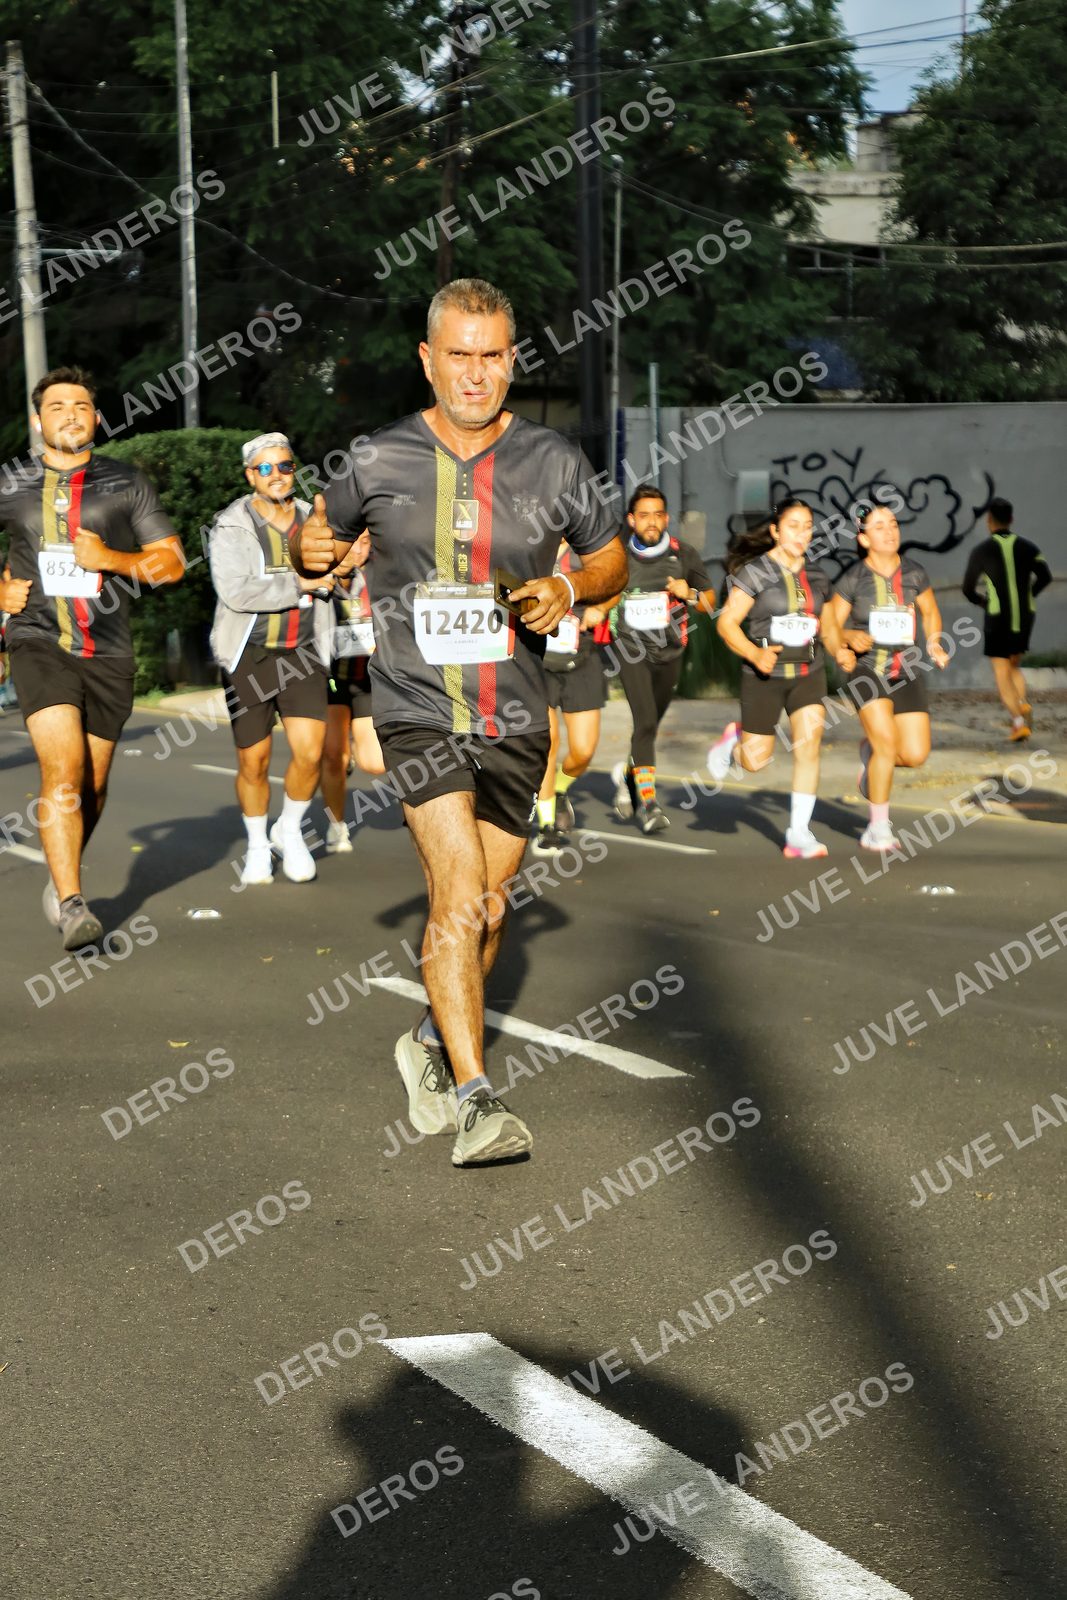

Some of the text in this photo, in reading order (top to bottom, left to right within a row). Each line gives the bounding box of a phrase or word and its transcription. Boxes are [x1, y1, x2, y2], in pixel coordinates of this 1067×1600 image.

[772, 447, 864, 482] TOY
[46, 559, 86, 577] 852
[420, 608, 503, 635] 12420
